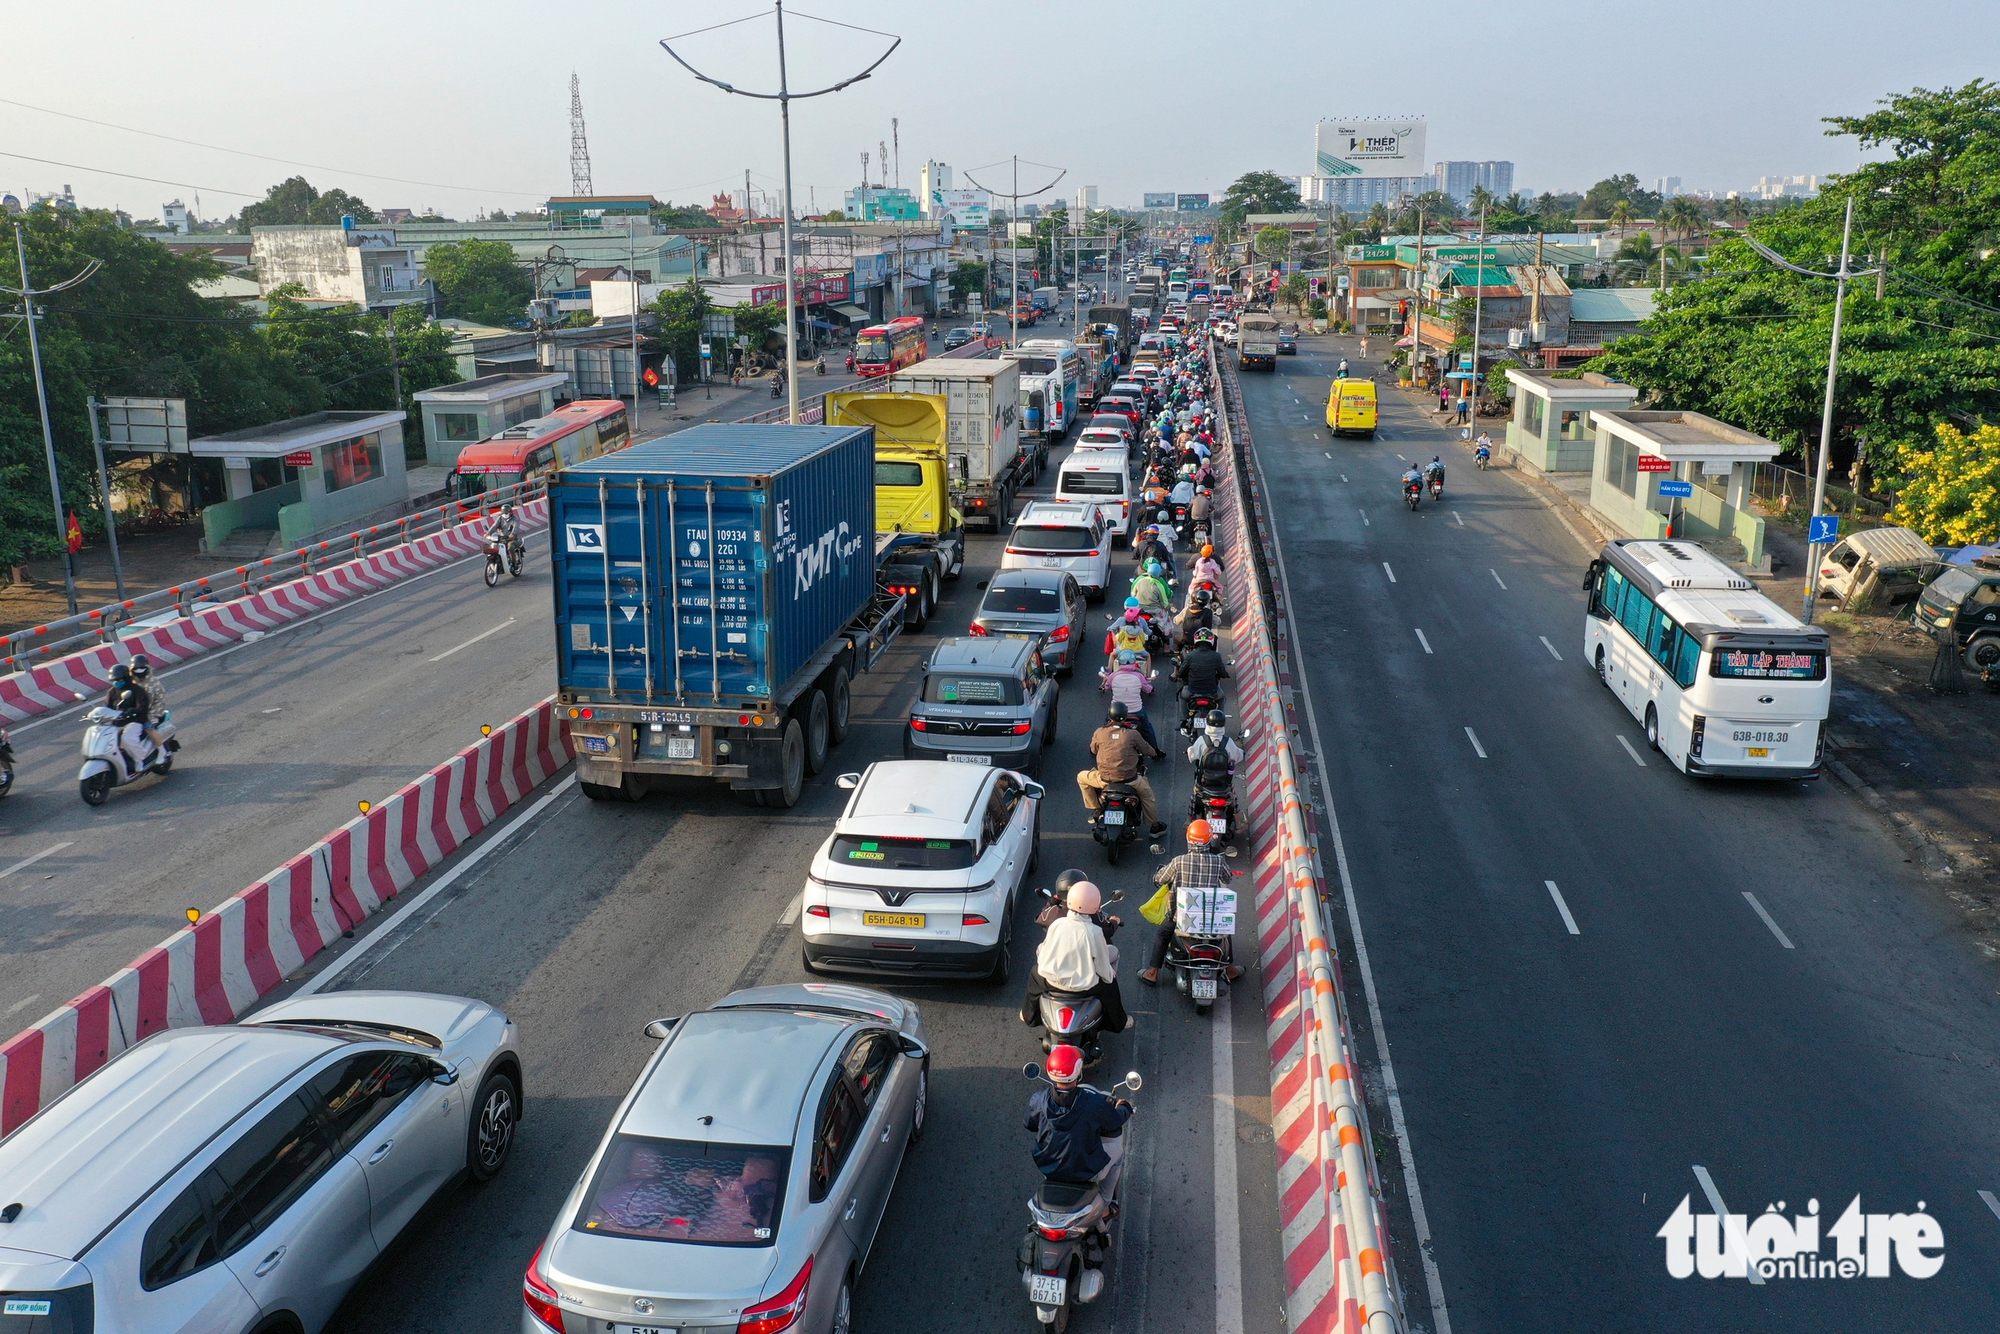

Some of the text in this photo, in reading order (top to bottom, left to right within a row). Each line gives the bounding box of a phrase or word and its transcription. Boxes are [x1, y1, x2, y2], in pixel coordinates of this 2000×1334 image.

[1366, 136, 1396, 146] THÉP
[579, 532, 594, 543] K
[687, 529, 760, 541] FTAU 109334 8
[718, 544, 737, 555] 22G1
[694, 560, 709, 568] GROSS
[681, 579, 693, 587] TARE
[694, 598, 709, 606] CARGO
[693, 616, 704, 625] CAP.
[1728, 650, 1812, 669] TÂN LẬP THÀNH
[1733, 731, 1788, 743] 63B-018.30
[675, 740, 689, 748] 51R
[670, 748, 692, 757] 139.96
[868, 915, 920, 926] 65H-048.19
[1036, 1277, 1060, 1290] 37-E1
[1032, 1290, 1062, 1303] 867.61
[30, 1304, 47, 1312] ĐỒNG
